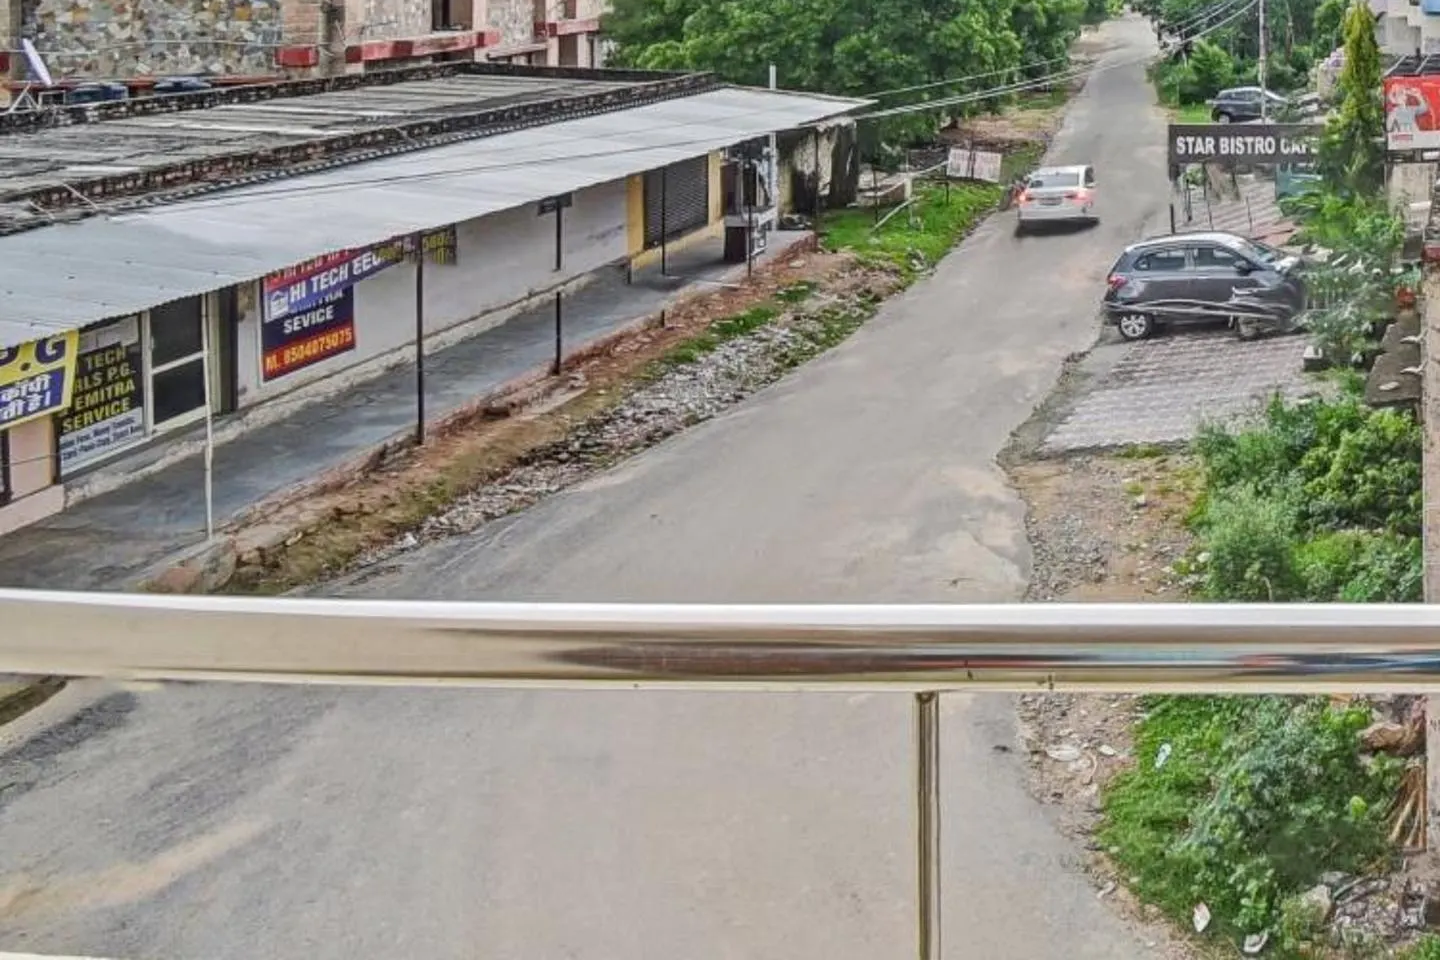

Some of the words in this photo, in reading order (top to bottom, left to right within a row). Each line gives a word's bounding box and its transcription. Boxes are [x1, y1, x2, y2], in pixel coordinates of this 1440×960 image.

[1176, 136, 1215, 155] STAR
[1219, 135, 1276, 155] BISTRO
[290, 283, 307, 303] HI
[313, 263, 350, 293] TECH
[283, 305, 335, 334] SEVICE
[62, 397, 132, 432] SERVICE
